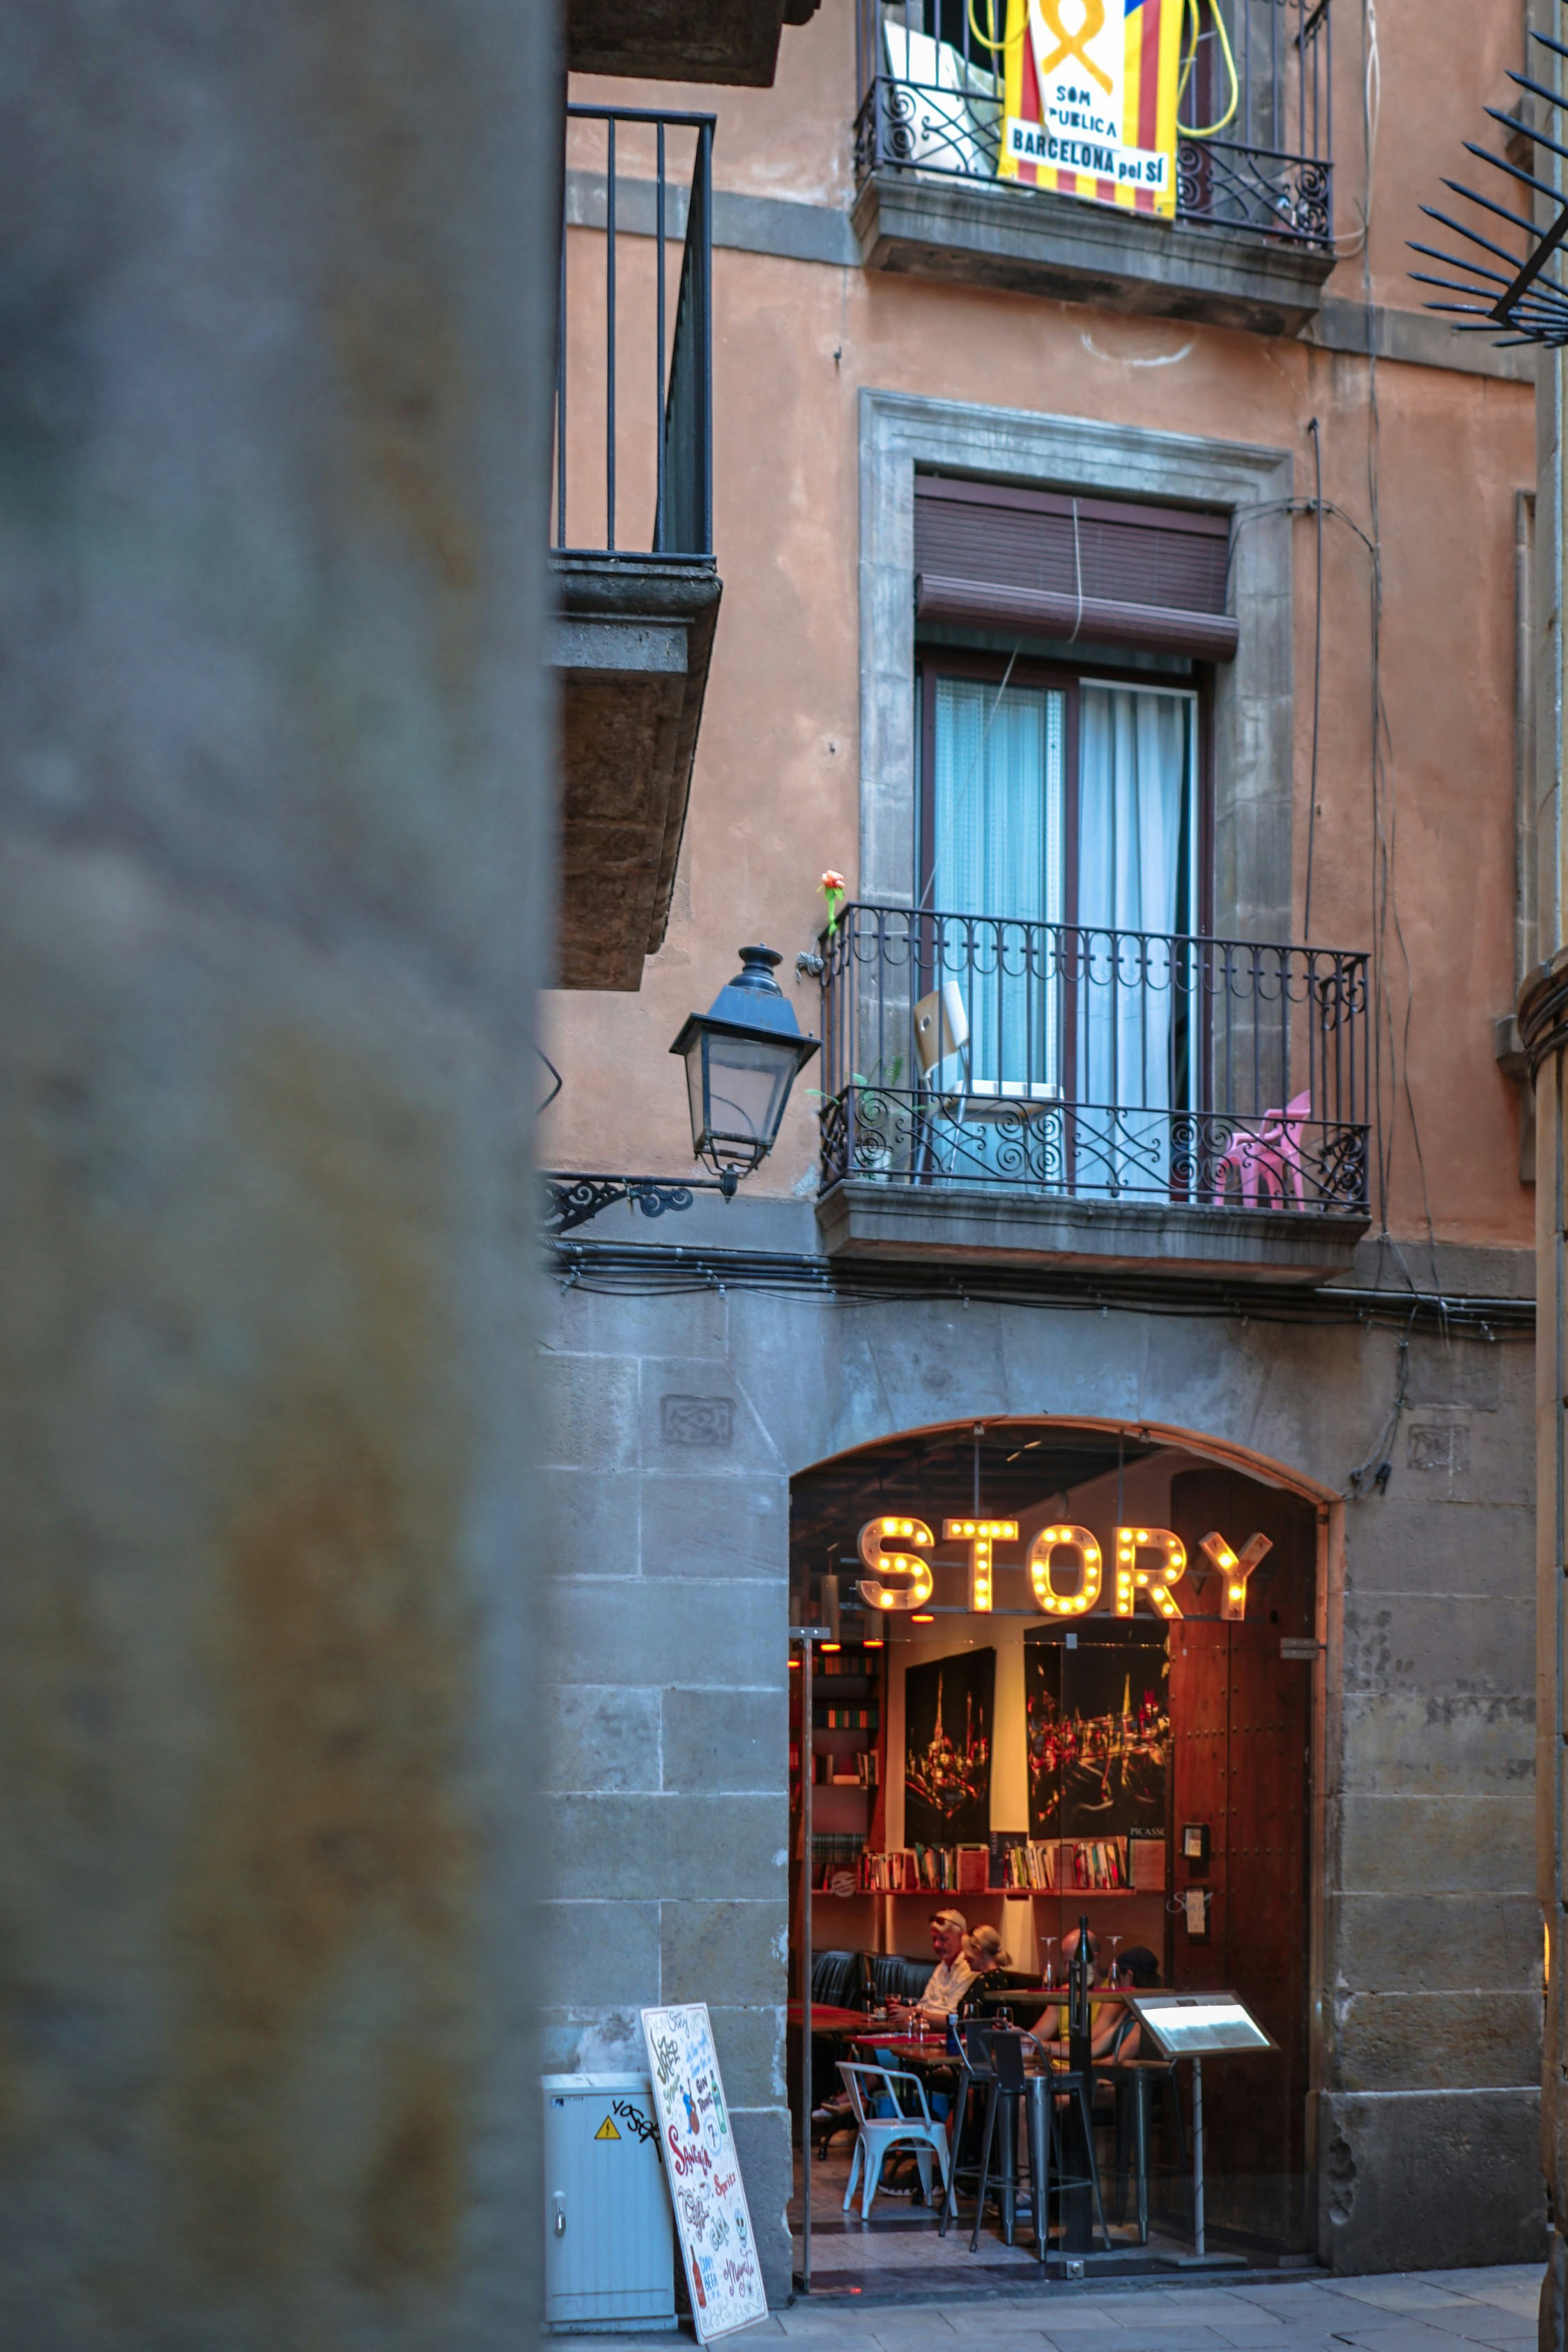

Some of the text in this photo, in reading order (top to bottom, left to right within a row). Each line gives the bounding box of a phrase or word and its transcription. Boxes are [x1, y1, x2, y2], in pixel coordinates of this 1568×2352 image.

[1056, 85, 1091, 107] SOM
[1013, 128, 1114, 174] BARCELONA
[1119, 161, 1142, 180] pel
[856, 1516, 1273, 1620] STORY
[695, 2075, 708, 2095] GIN
[704, 2273, 718, 2291] BEER
